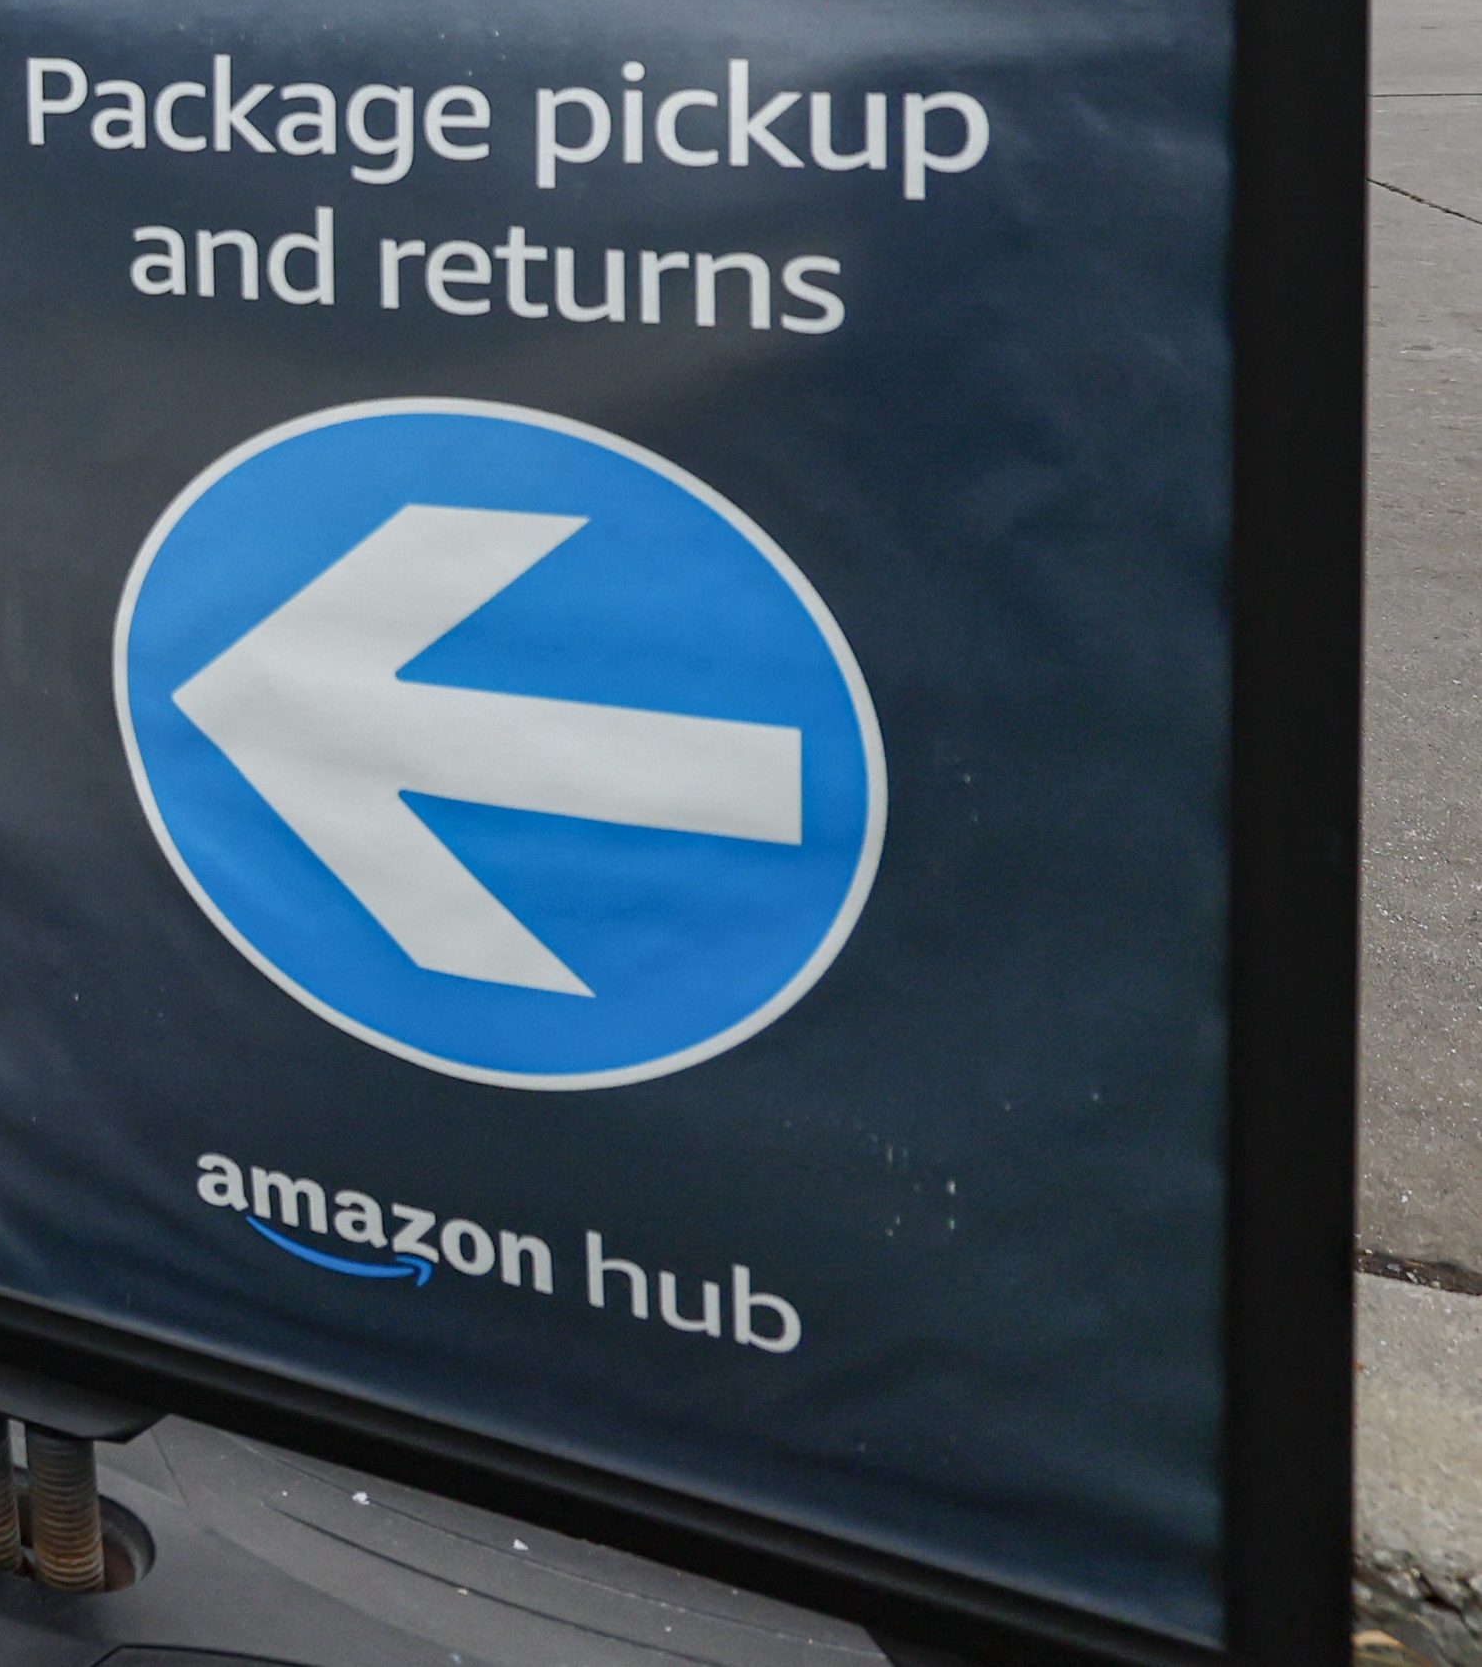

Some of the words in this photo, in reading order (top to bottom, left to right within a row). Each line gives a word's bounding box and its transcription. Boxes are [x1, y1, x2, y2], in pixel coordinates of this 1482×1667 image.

[24, 53, 493, 184] Package
[535, 57, 990, 201] pickup
[130, 206, 336, 306] and
[379, 224, 847, 335] returns
[196, 1152, 555, 1294] amazon
[586, 1230, 803, 1355] hub
